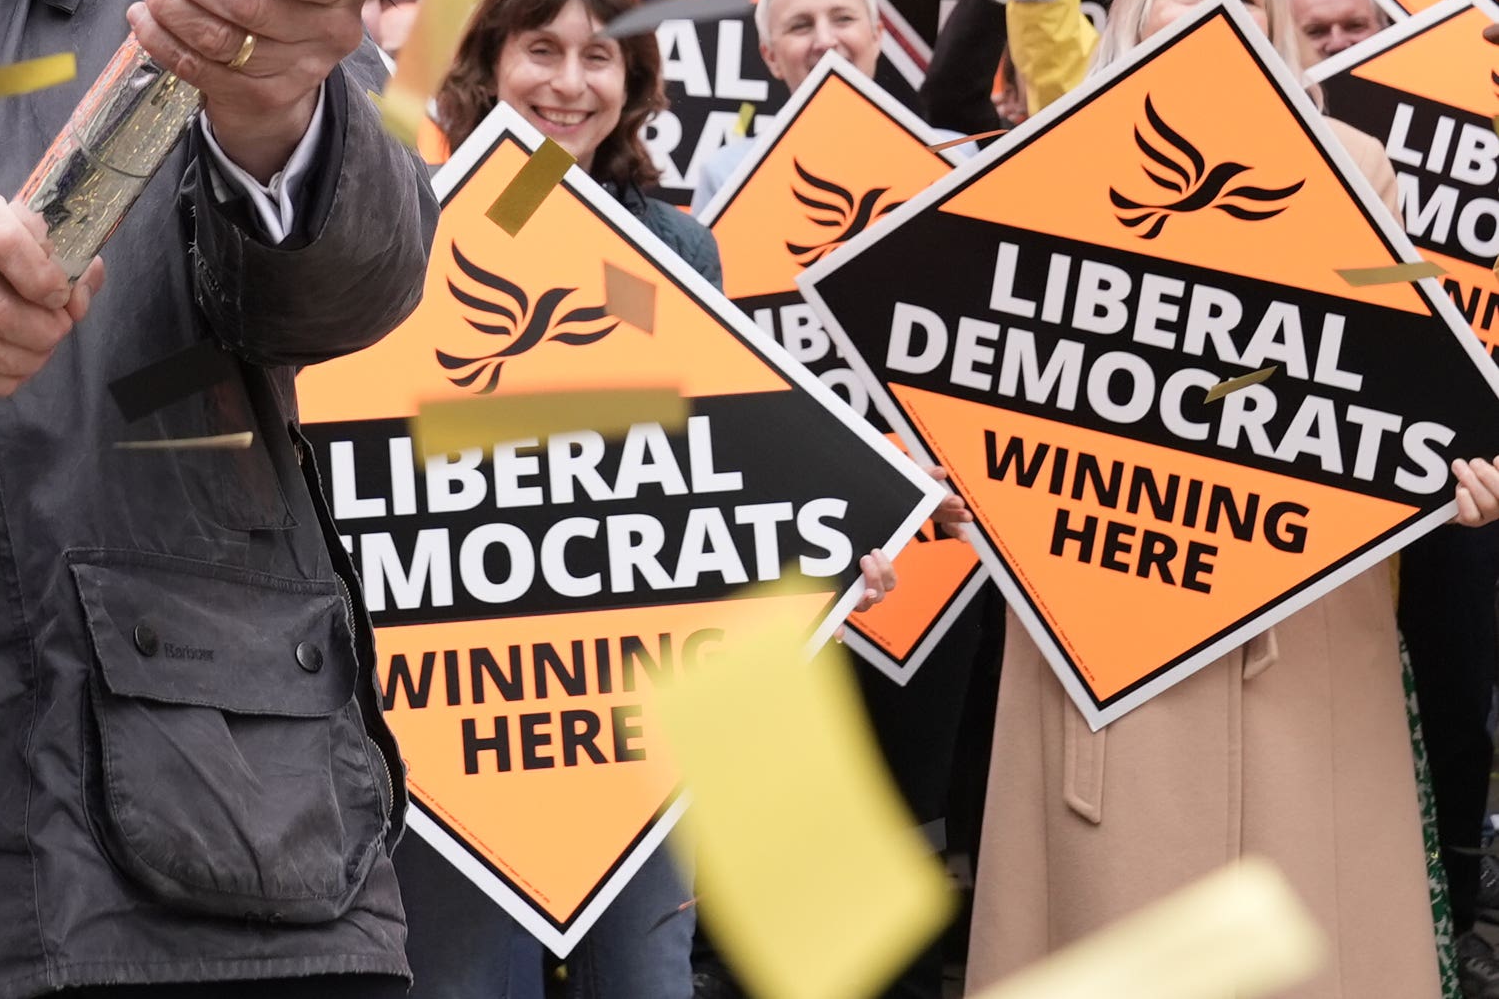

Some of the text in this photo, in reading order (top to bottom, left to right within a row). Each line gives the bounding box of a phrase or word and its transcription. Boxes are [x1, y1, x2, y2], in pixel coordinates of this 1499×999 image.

[989, 241, 1363, 392] LIBERAL
[885, 301, 1456, 495] DEMOCRATS
[330, 416, 743, 520] LIBERAL
[983, 429, 1310, 554] WINNING
[344, 497, 854, 613] MOCRATS
[1049, 509, 1218, 594] HERE
[461, 704, 647, 775] HERE
